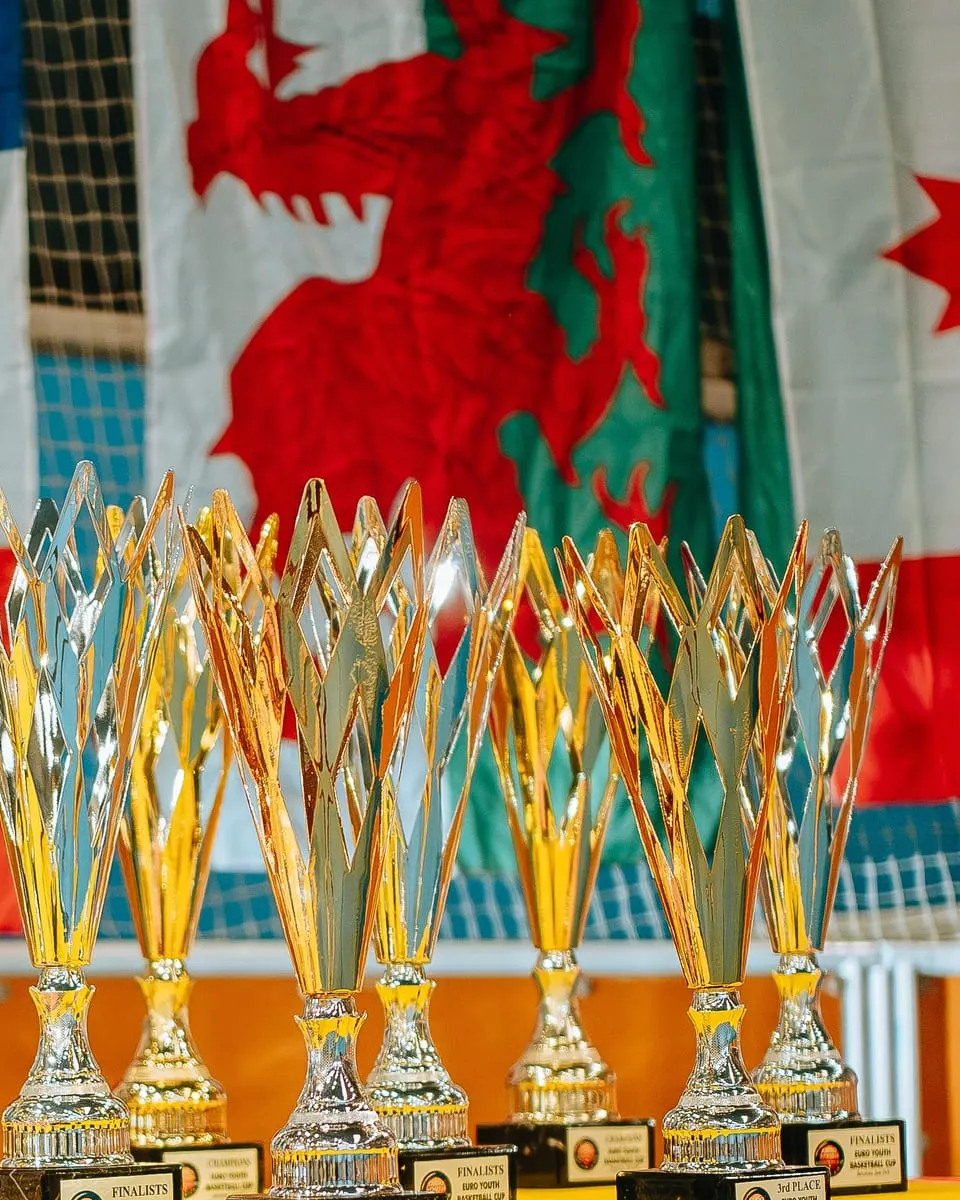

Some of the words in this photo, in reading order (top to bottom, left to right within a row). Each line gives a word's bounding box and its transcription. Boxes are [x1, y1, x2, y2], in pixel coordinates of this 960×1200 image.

[850, 1134, 895, 1145] FINALISTS
[872, 1148, 891, 1156] YOUTH
[850, 1161, 884, 1169] BASKETBALL
[885, 1159, 896, 1167] CUP
[457, 1164, 504, 1178] FINALISTS
[112, 1183, 168, 1198] FINALISTS
[462, 1182, 478, 1191] EURO
[480, 1181, 500, 1189] YOUTH
[777, 1183, 790, 1193] 3rd
[792, 1179, 821, 1191] PLACE
[494, 1192, 505, 1200] CUP
